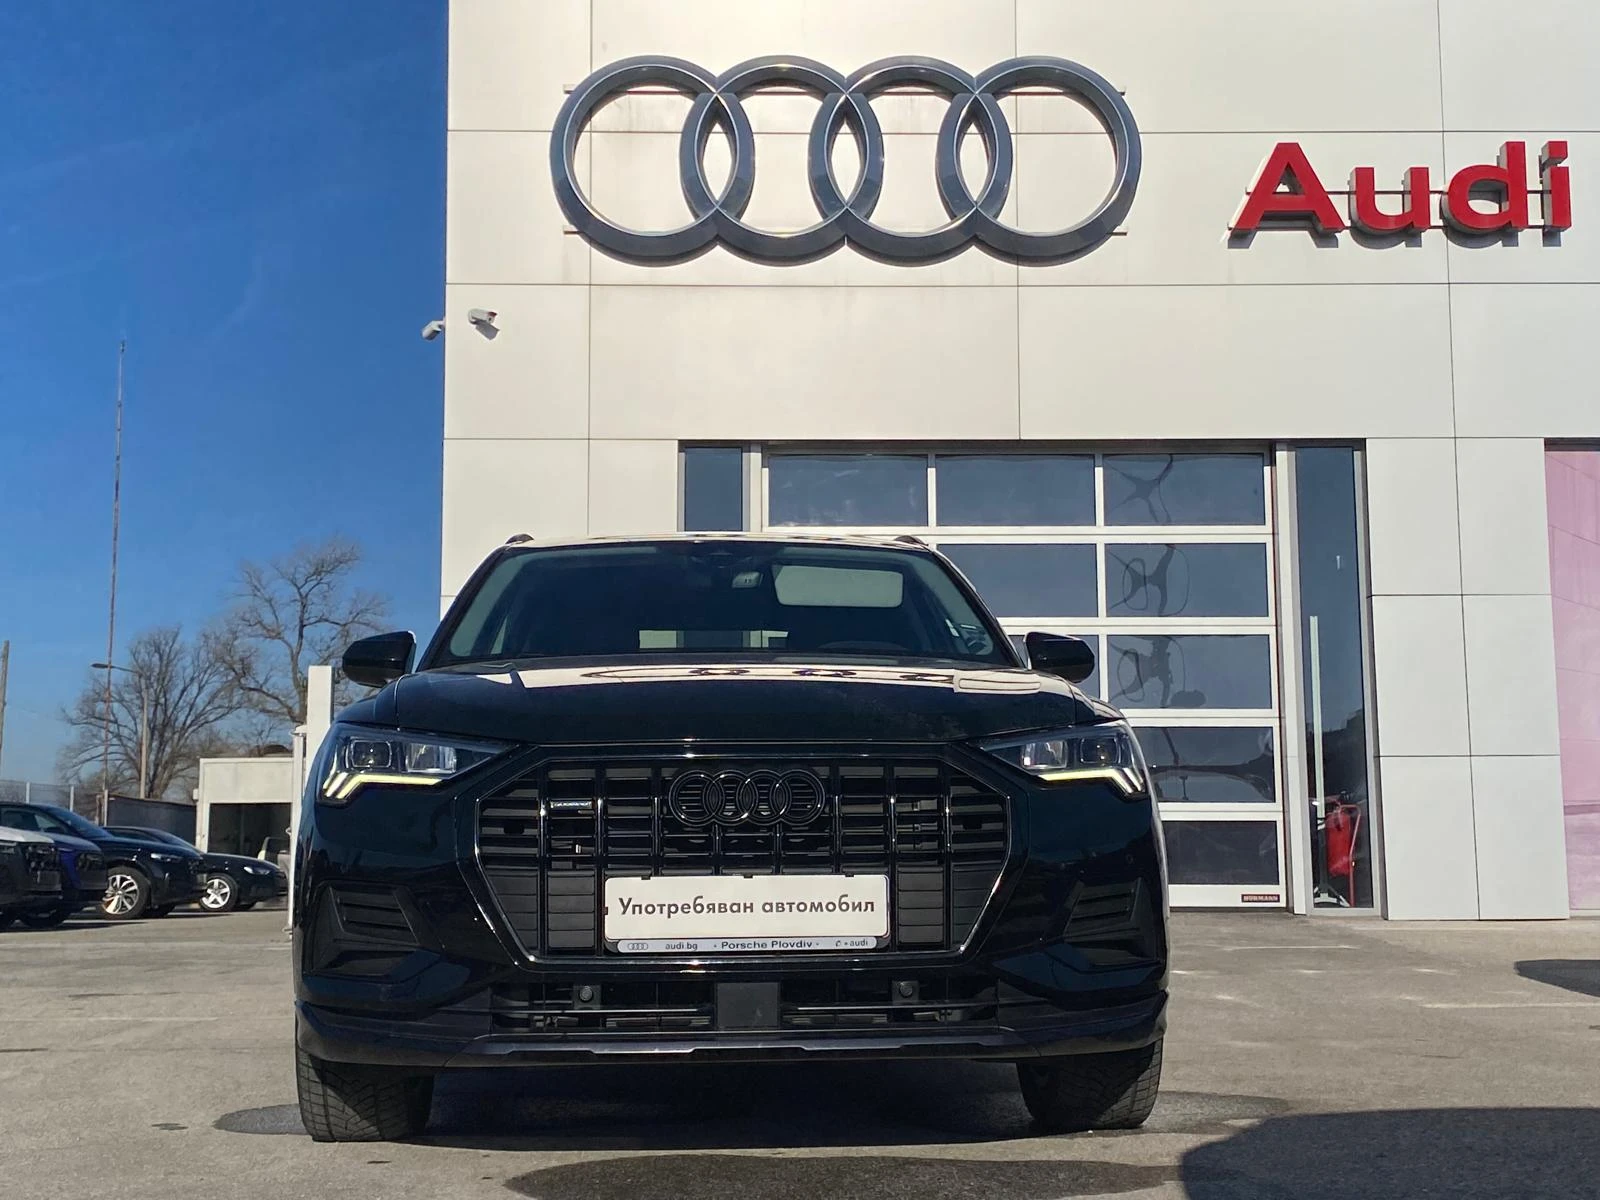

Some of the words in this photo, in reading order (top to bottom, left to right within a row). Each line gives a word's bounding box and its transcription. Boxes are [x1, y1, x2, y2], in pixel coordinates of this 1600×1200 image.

[1229, 140, 1572, 233] Audi
[618, 895, 754, 918] Употребяван
[761, 894, 875, 913] автомобил
[665, 941, 698, 951] audi.bg
[721, 941, 768, 949] Porsche
[771, 940, 813, 949] Plovdiv
